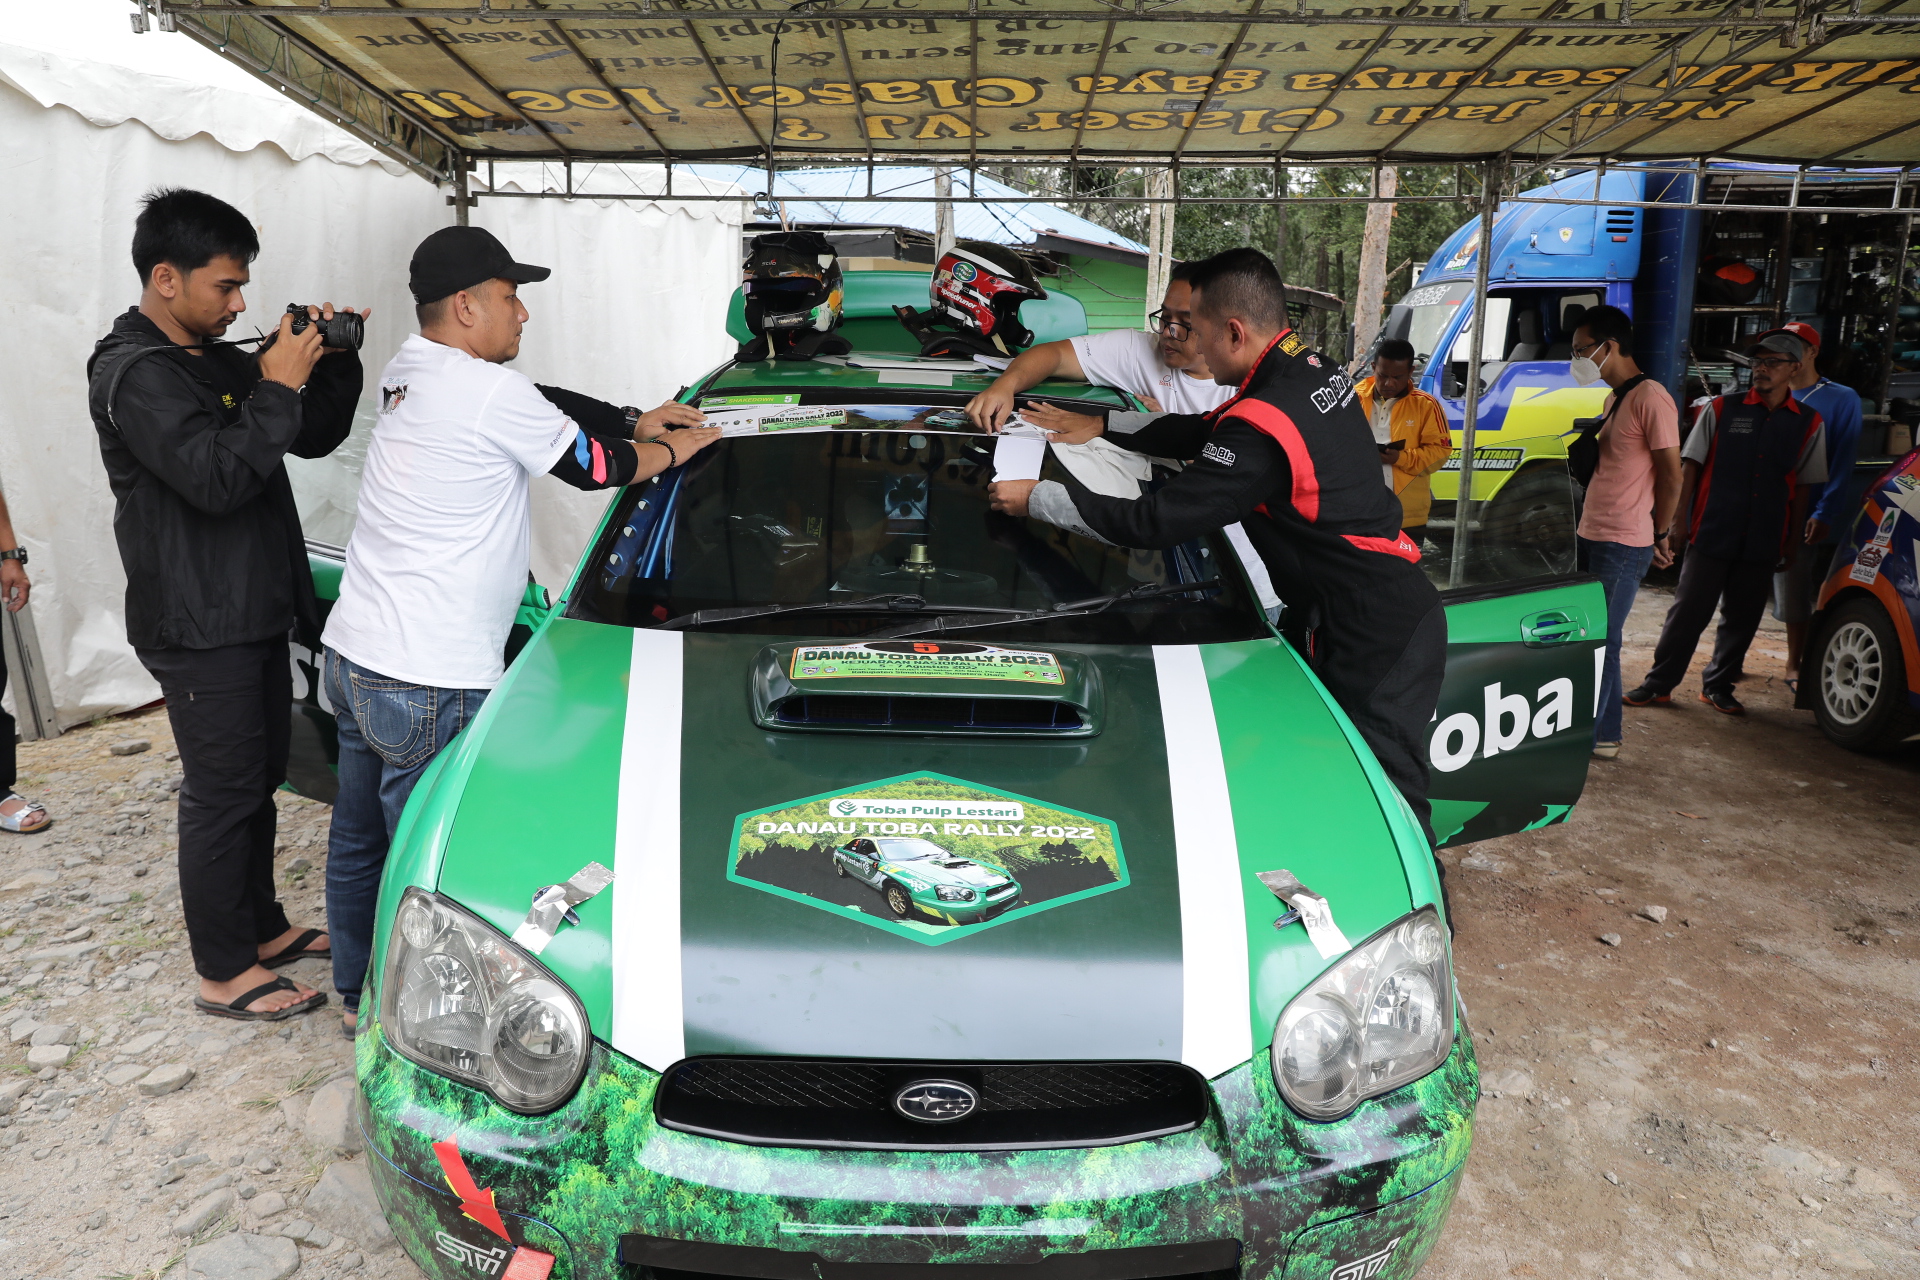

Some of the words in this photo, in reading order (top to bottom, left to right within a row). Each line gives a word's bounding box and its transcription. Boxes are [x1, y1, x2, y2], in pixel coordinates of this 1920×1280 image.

[859, 45, 971, 61] seru
[1335, 36, 1497, 55] bikin
[1069, 68, 1268, 95] gaya
[1286, 65, 1632, 92] serunya
[703, 77, 1041, 109] Claser
[1012, 107, 1343, 134] Claser
[1369, 99, 1546, 125] jadi
[858, 114, 985, 140] VJ
[728, 396, 775, 404] SHAKEDOWN
[825, 410, 844, 418] 2022
[1216, 446, 1236, 463] Bla
[913, 643, 940, 653] 5
[803, 651, 871, 661] DANAU
[876, 652, 933, 661] TOBA
[936, 655, 996, 663] RALLY
[1000, 655, 1054, 667] 2022
[1430, 676, 1574, 773] oba
[862, 805, 907, 816] Toba
[911, 805, 952, 819] Pulp
[957, 806, 1018, 818] Lestari
[758, 821, 857, 836] DANAU
[862, 822, 940, 836] TOBA
[944, 823, 1026, 838] RALLY
[1031, 825, 1097, 840] 2022
